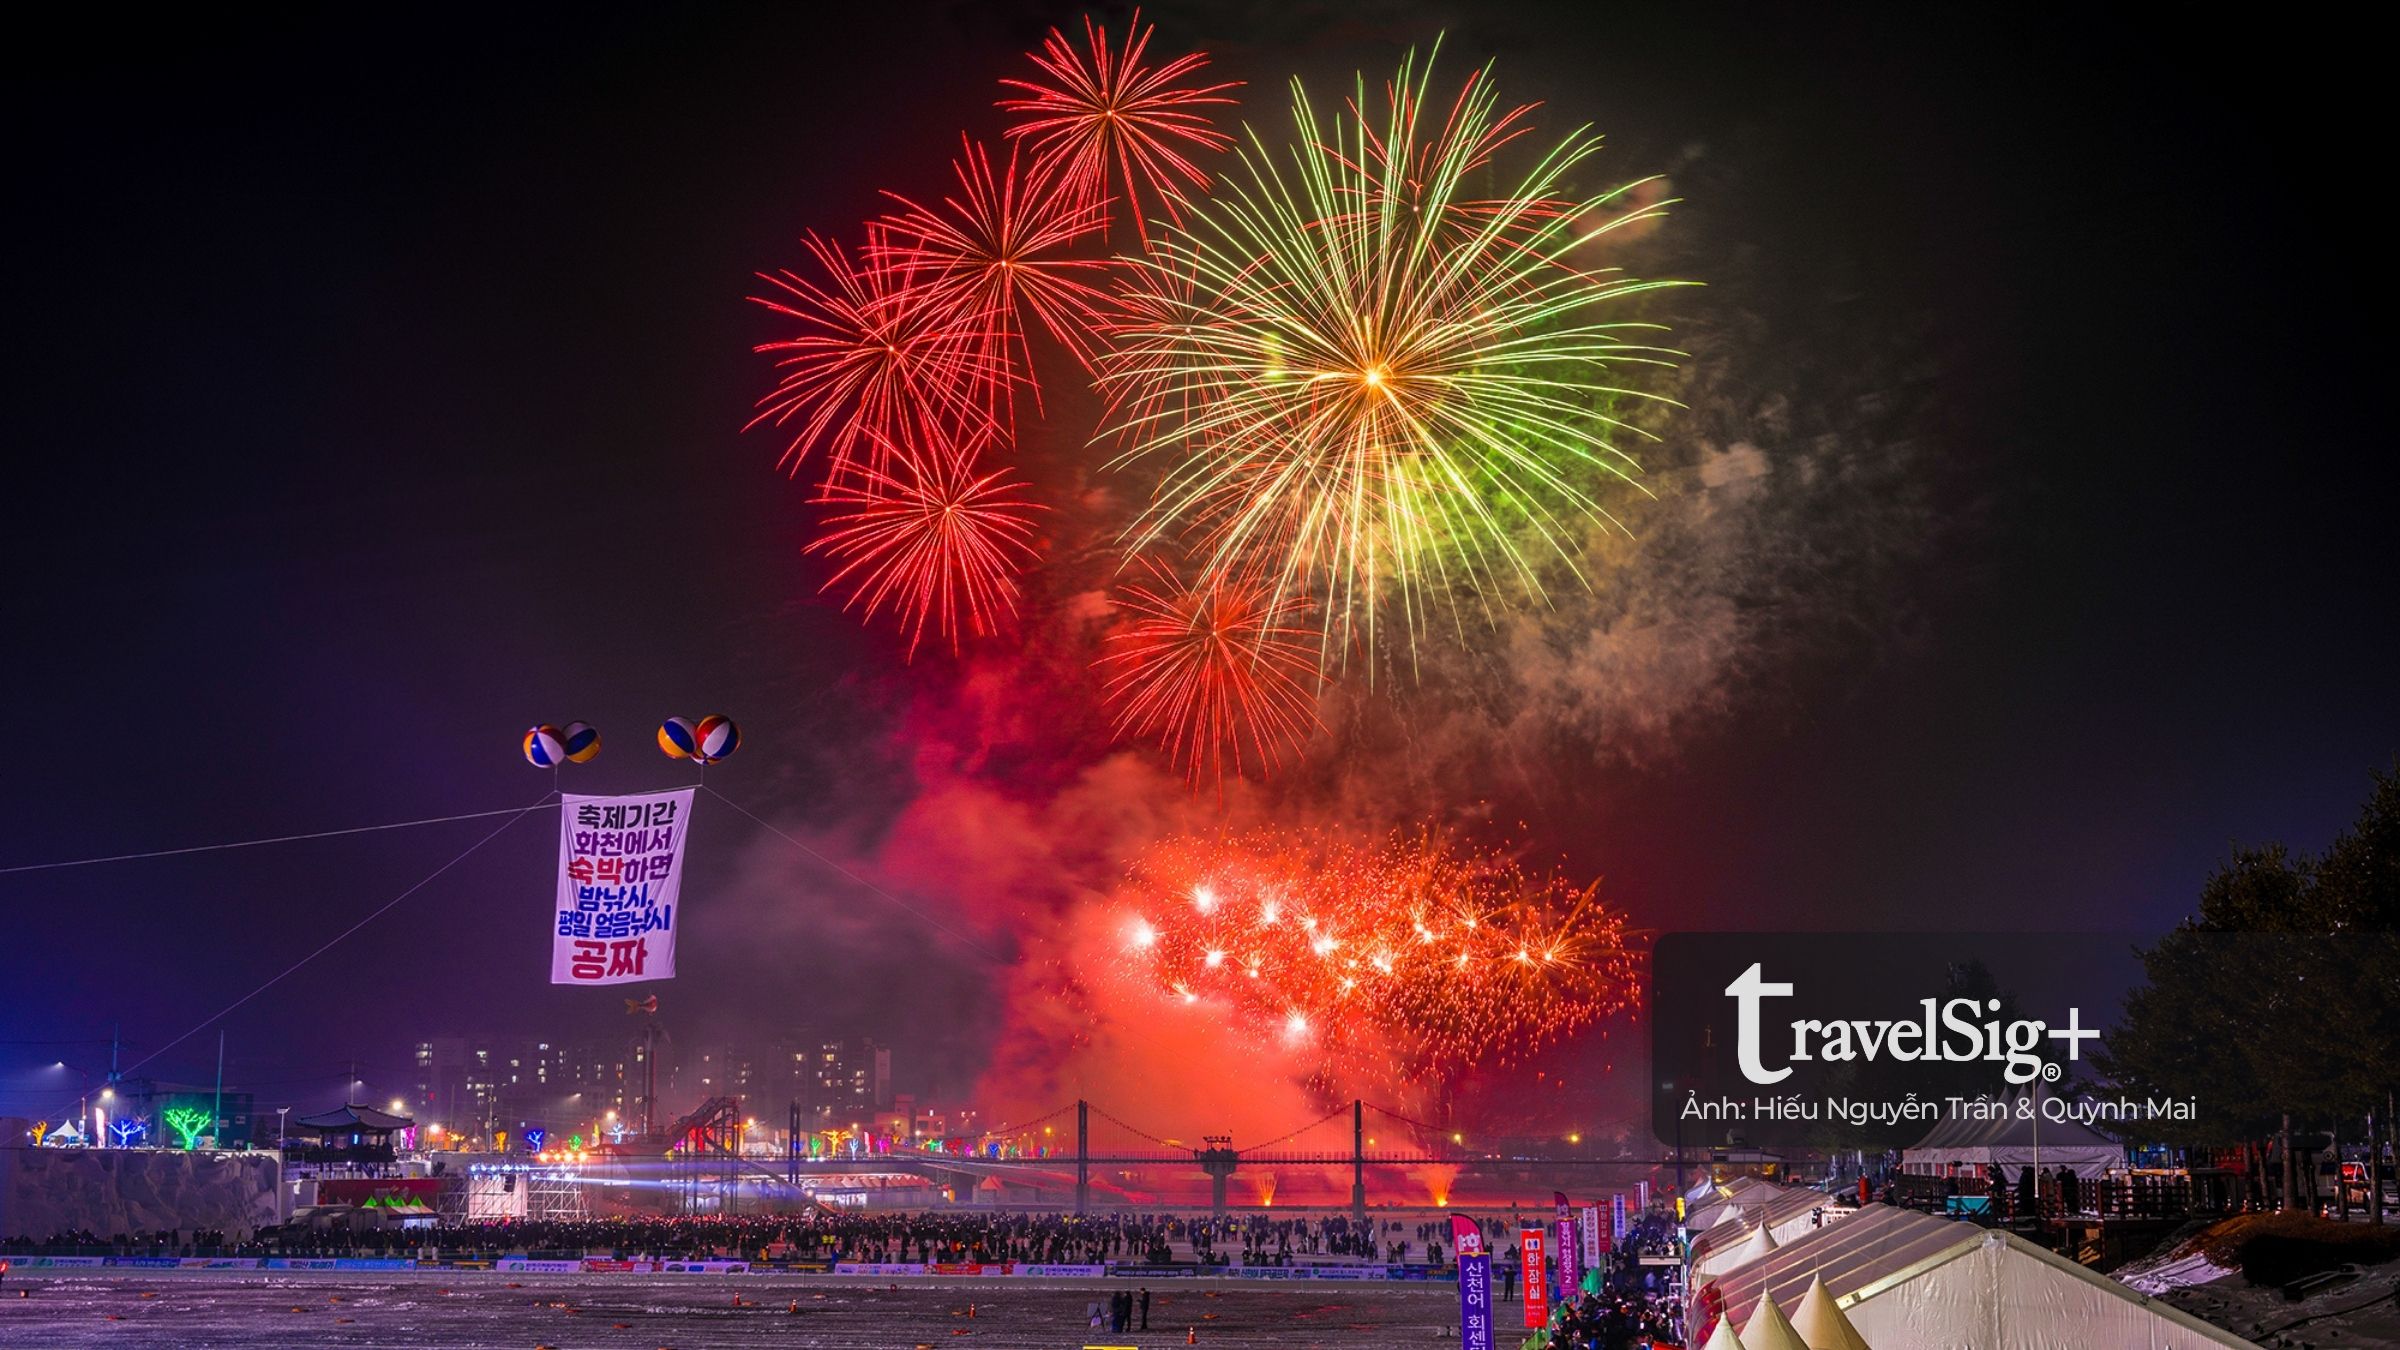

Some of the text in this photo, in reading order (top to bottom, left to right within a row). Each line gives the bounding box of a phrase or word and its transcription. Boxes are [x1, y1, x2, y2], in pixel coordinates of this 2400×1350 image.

[577, 801, 677, 830] 축제기간
[574, 827, 673, 857] 화천에서
[567, 853, 674, 885] 숙박하면
[578, 883, 655, 912] 밤낚시,
[558, 904, 671, 938] 평일 얼음낚시
[571, 937, 648, 980] 공짜
[1466, 1262, 1485, 1309] 산천어
[1527, 1251, 1541, 1299] 화장실
[1565, 1275, 1573, 1284] 2
[1467, 1314, 1487, 1350] 회센
